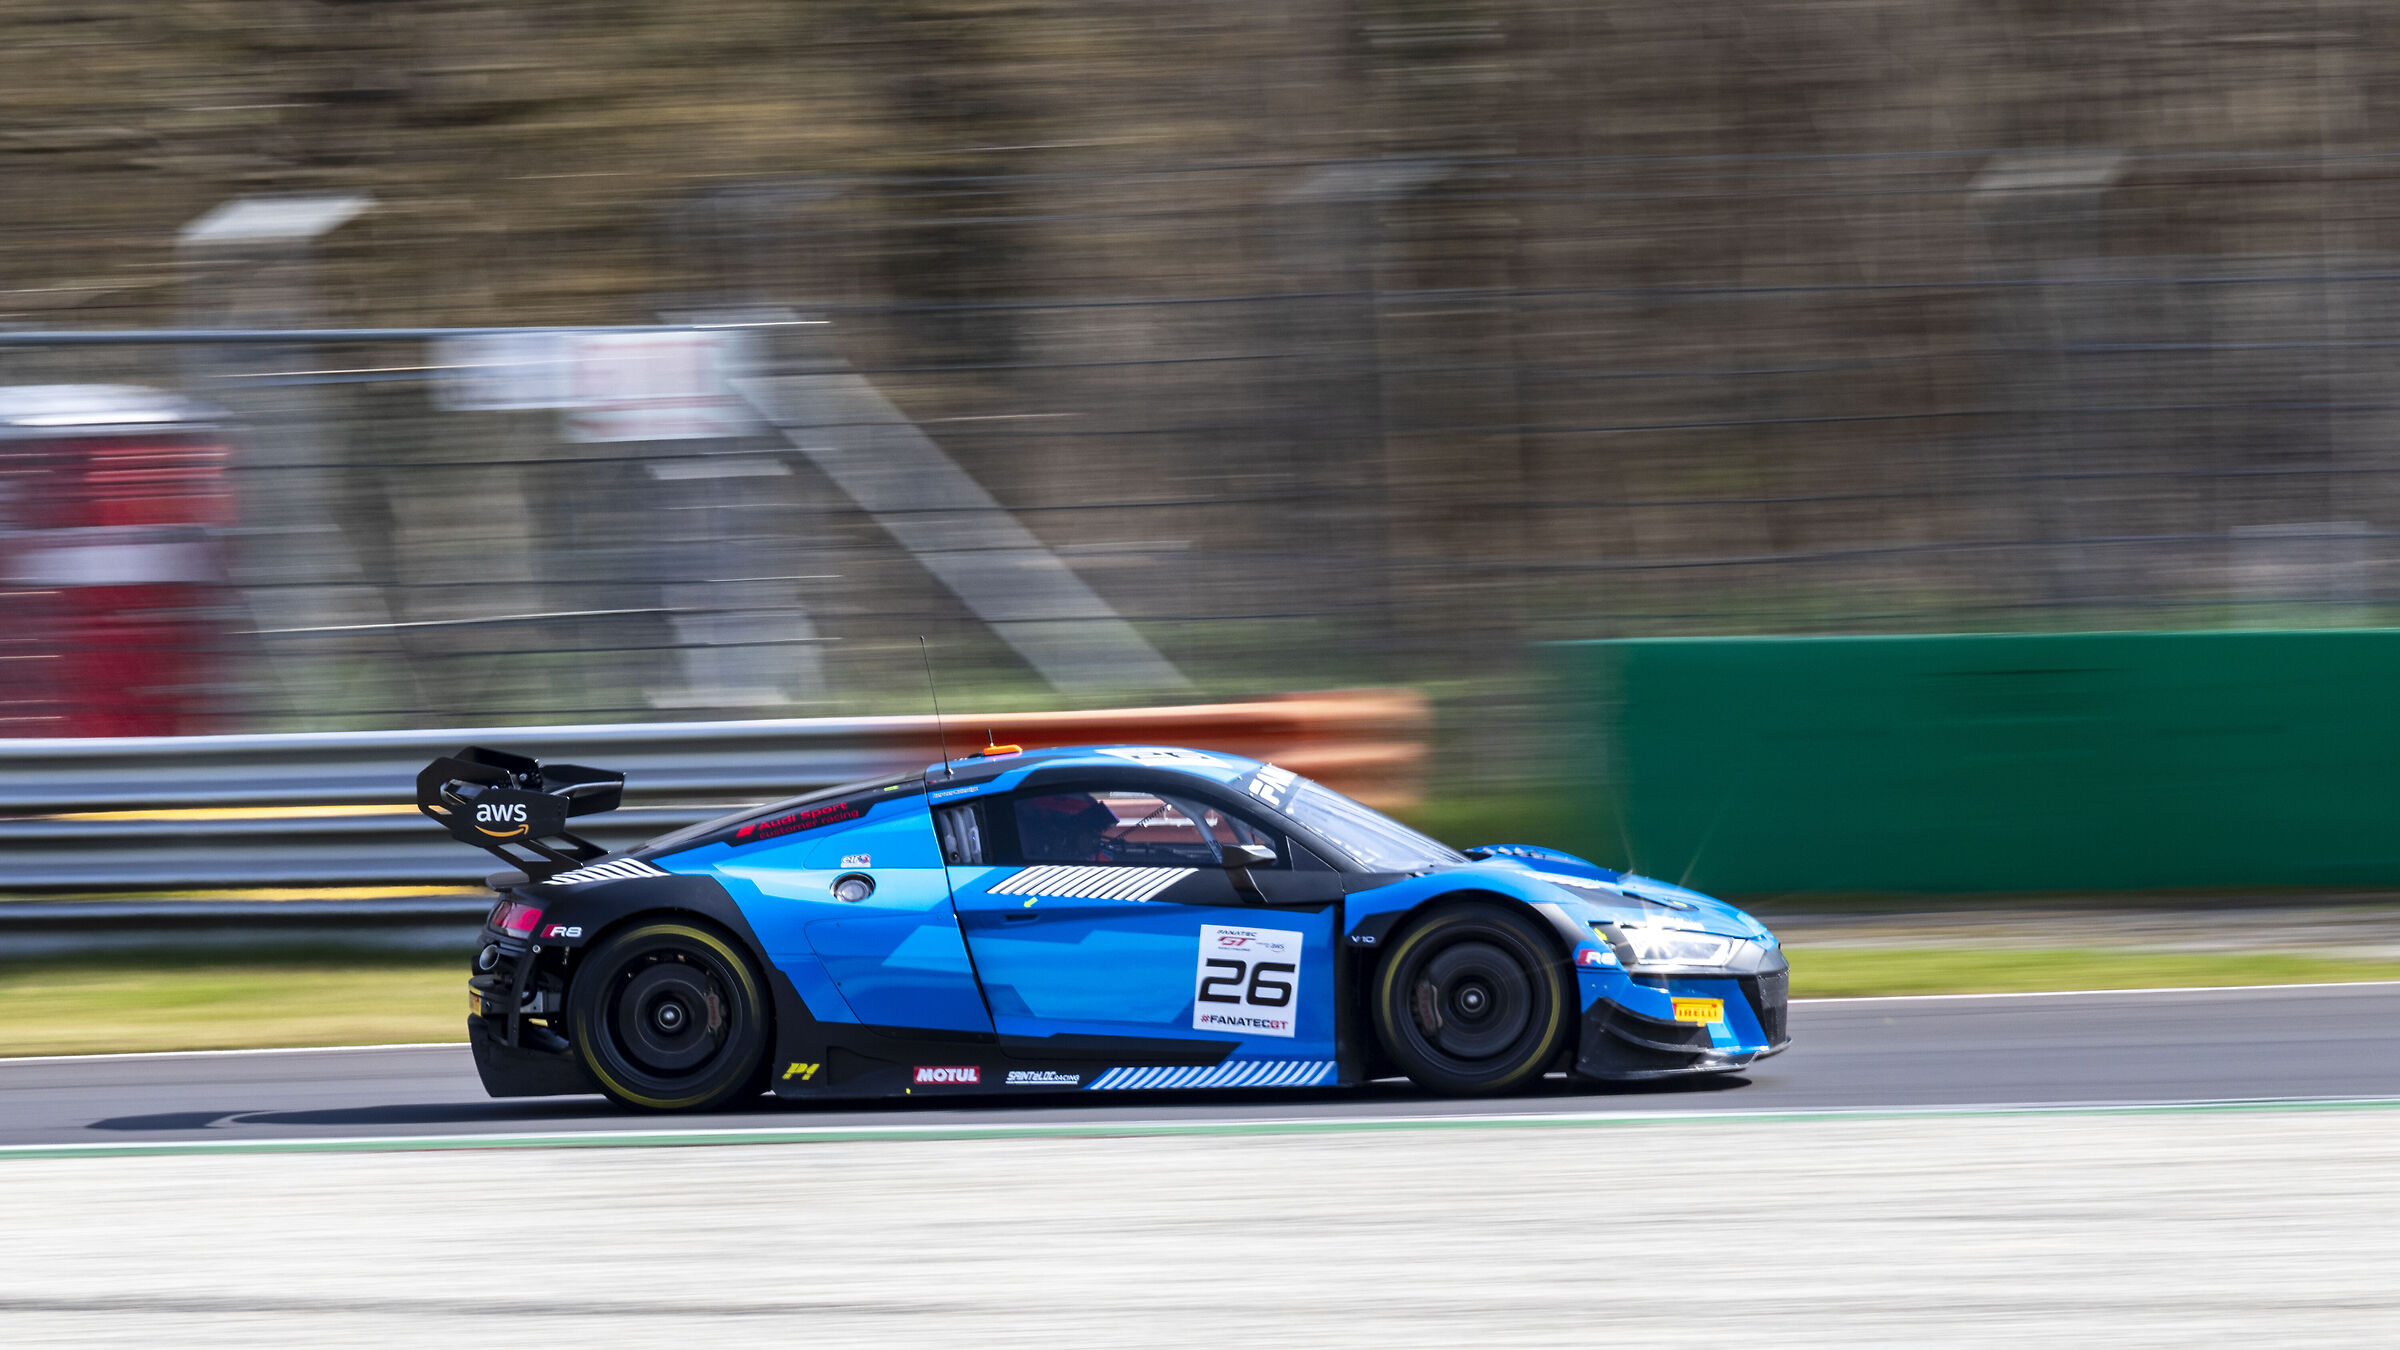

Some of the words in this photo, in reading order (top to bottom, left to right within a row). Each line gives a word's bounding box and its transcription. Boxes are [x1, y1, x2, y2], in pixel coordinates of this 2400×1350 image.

[476, 803, 528, 822] aws
[758, 813, 796, 831] Audi
[800, 802, 848, 819] Sport
[760, 819, 817, 839] customer
[820, 810, 859, 826] racing
[549, 926, 582, 938] R8
[1217, 929, 1257, 938] FANATEC
[1198, 957, 1296, 1008] 26
[1200, 1013, 1289, 1030] #FANATECGT
[916, 1068, 978, 1083] MOTUL
